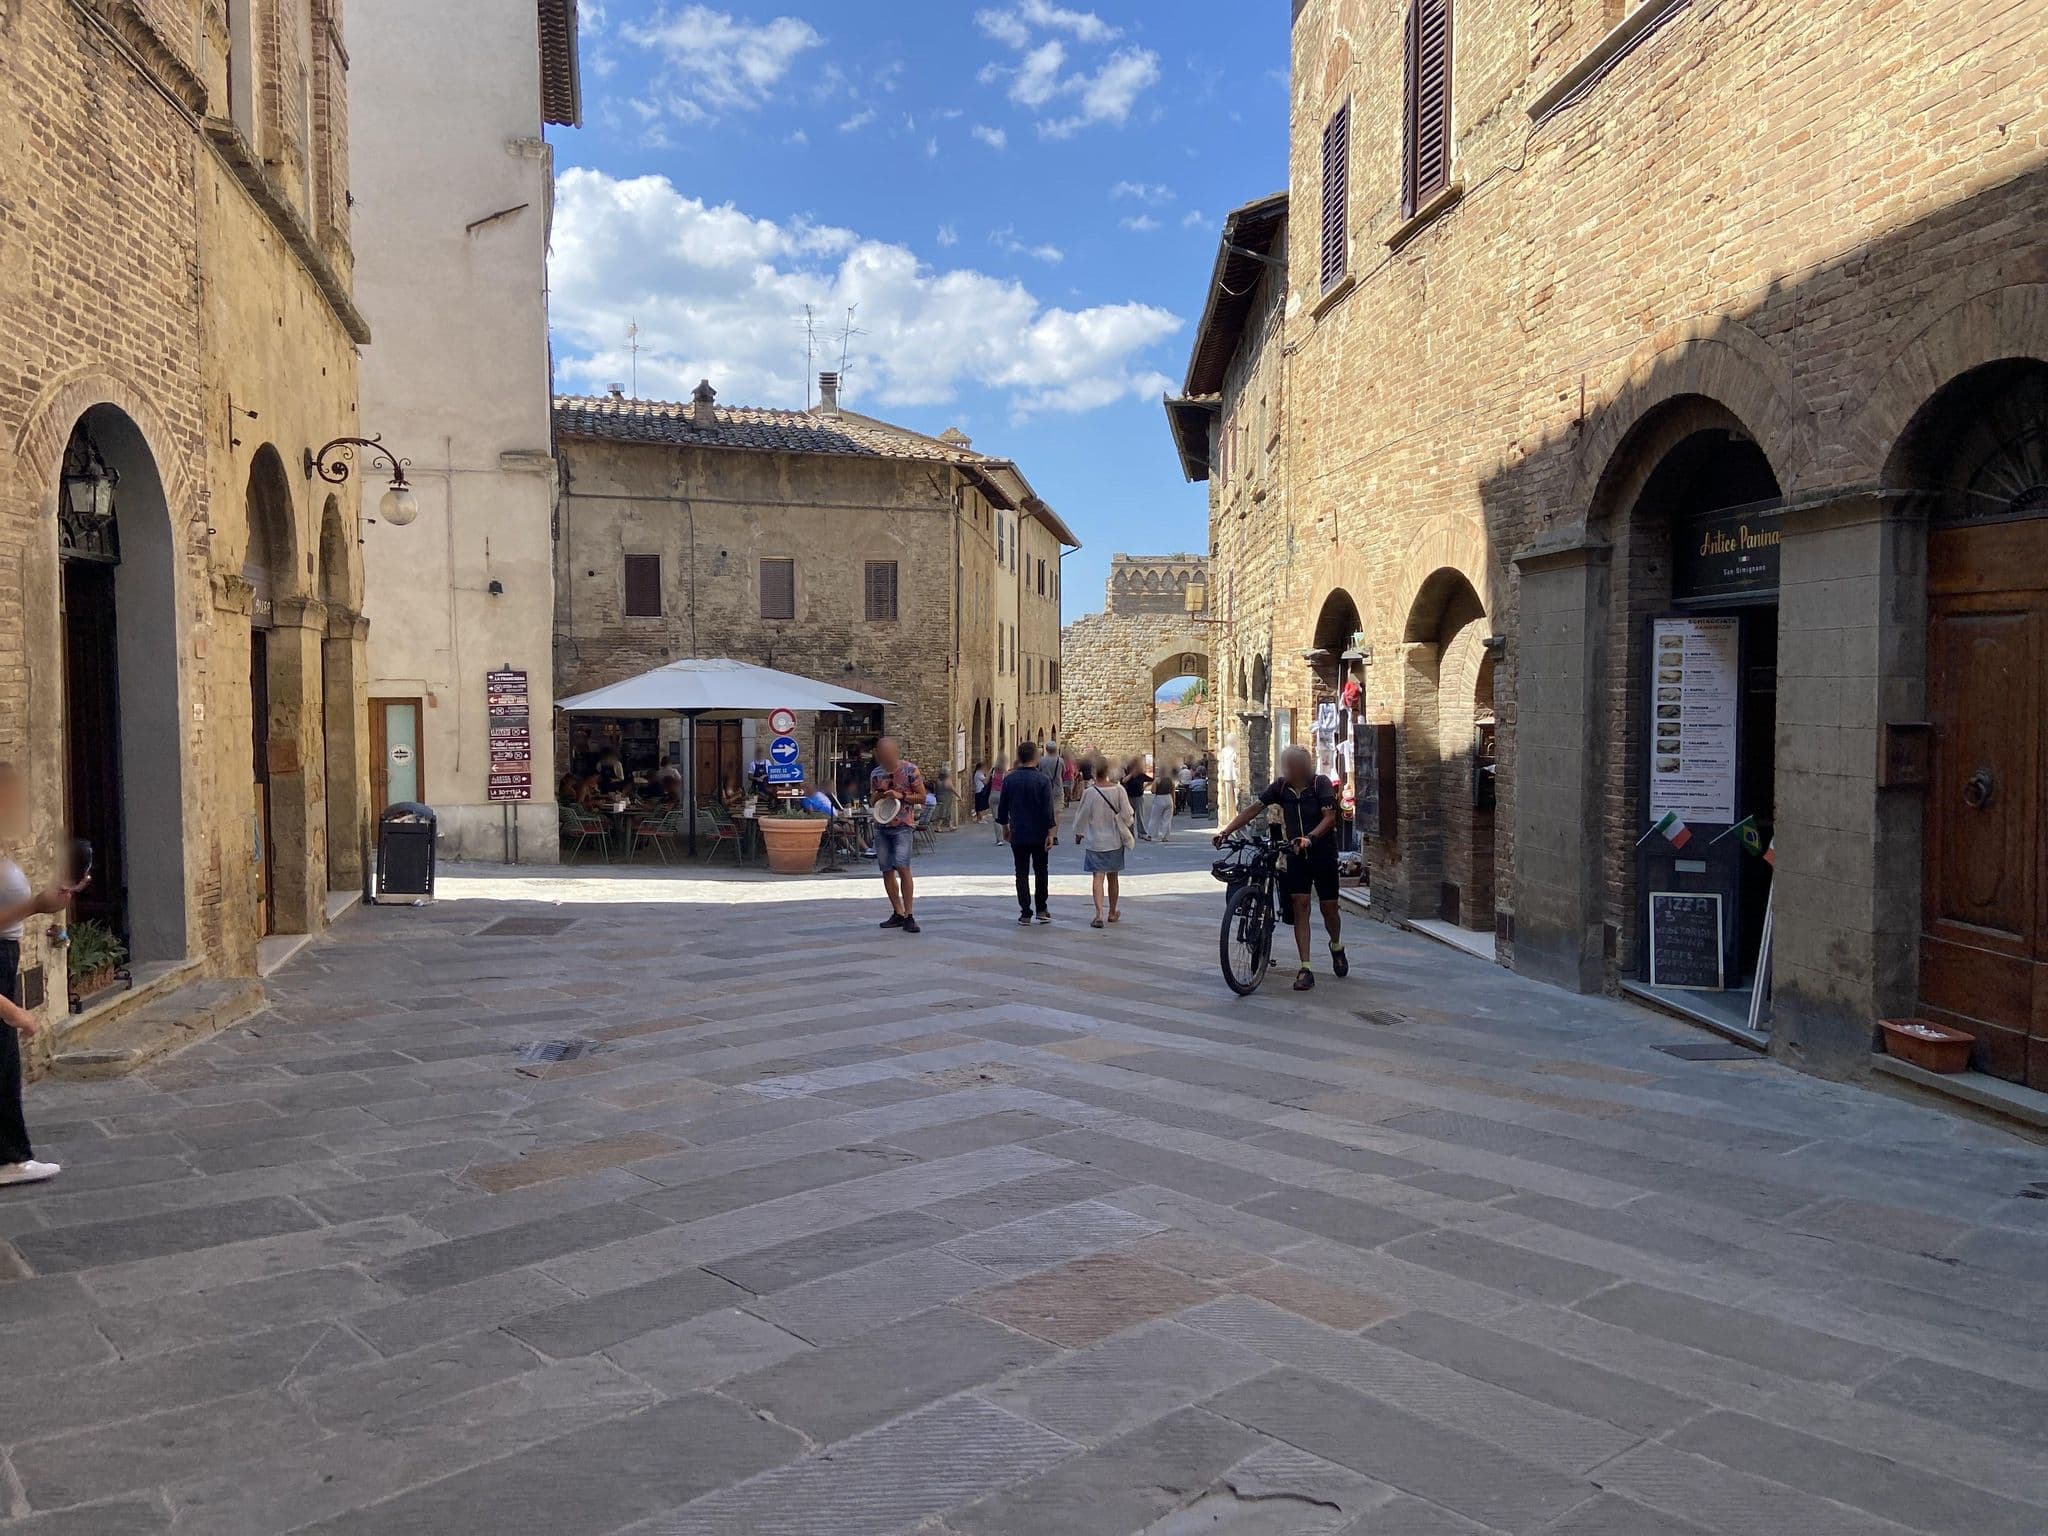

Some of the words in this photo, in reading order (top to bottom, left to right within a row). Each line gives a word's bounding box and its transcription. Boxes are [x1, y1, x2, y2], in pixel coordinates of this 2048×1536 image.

[1739, 525, 1781, 550] Panina
[1723, 568, 1734, 576] San
[1655, 896, 1708, 912] PIZZA
